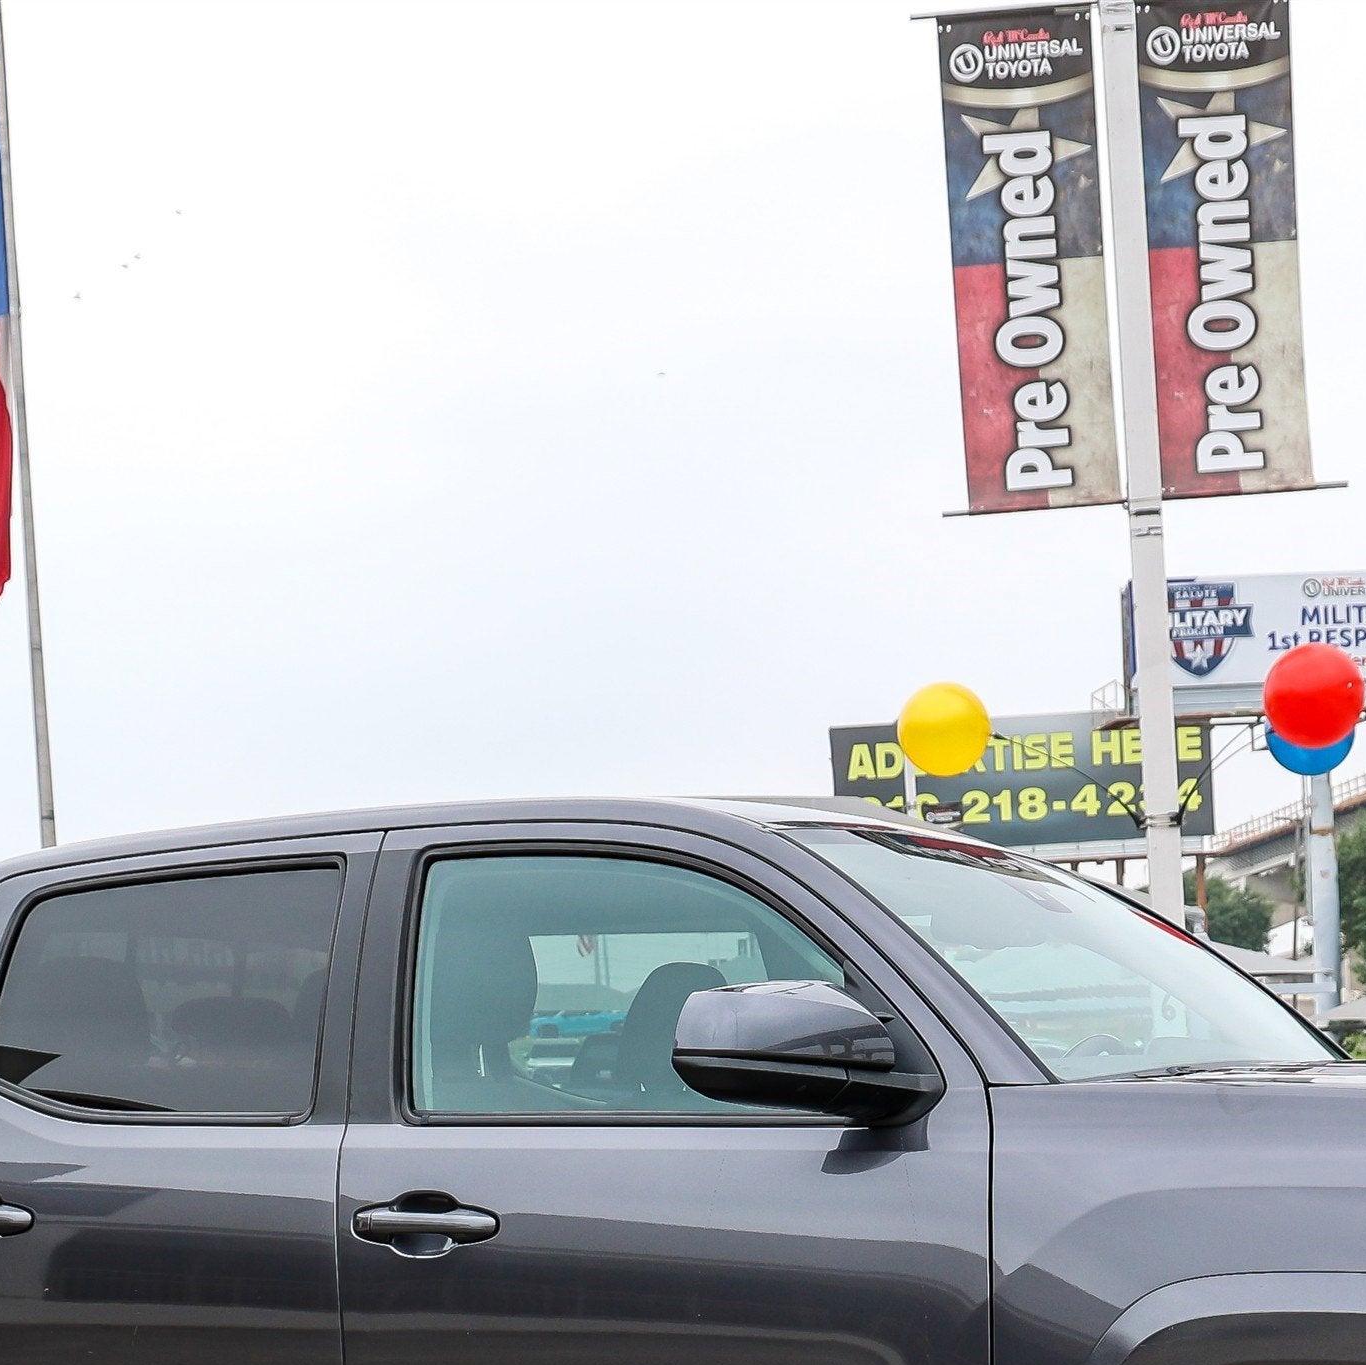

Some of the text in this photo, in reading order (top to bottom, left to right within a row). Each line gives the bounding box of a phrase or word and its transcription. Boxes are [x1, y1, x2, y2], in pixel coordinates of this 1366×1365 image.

[1181, 21, 1281, 44] UNIVERSAL
[985, 38, 1083, 61] UNIVERSAL
[1182, 41, 1250, 63] TOYOTA
[985, 58, 1053, 80] TOYOTA
[1177, 114, 1265, 473] Pre Owned
[982, 129, 1073, 491] Pre Owned
[1267, 631, 1301, 650] 1st
[1092, 726, 1203, 766] HEE
[962, 778, 1203, 824] 218-424
